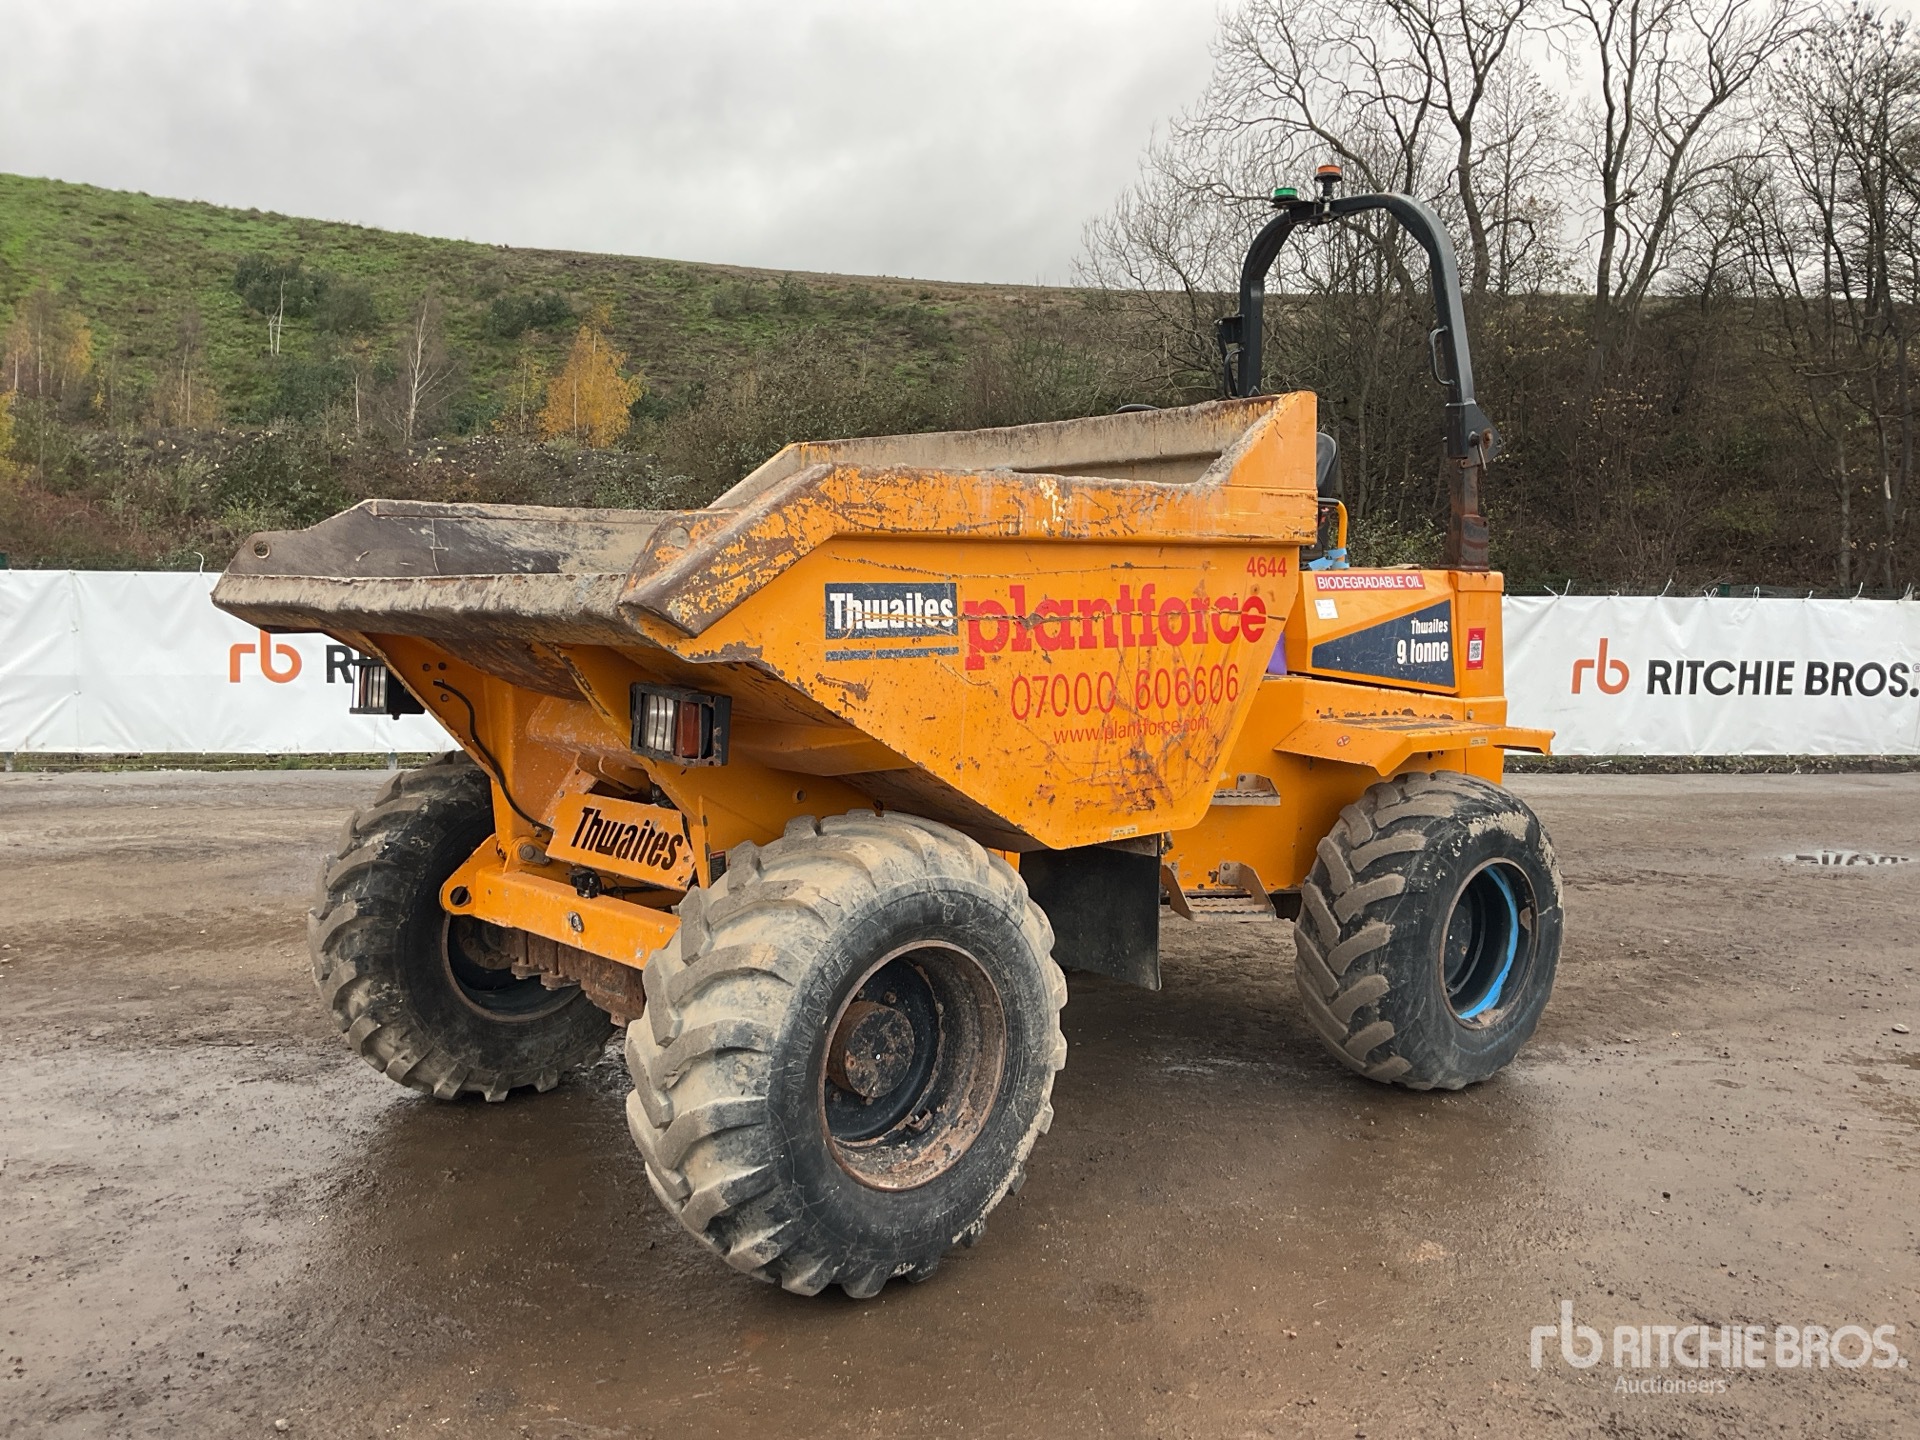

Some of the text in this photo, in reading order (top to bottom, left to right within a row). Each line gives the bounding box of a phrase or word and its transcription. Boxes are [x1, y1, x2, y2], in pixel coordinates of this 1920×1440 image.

[1246, 556, 1287, 578] 4644
[1317, 574, 1423, 590] BIODEGRADABLE OIL
[829, 592, 954, 630] Thwaites
[964, 583, 1267, 671] plantforce
[1411, 618, 1449, 635] Thwaites
[1397, 639, 1449, 664] 9 tonne
[1571, 638, 1630, 695] rb
[1010, 664, 1239, 721] 07000 606606
[1647, 660, 1919, 698] RITCHIE BROS.
[571, 806, 684, 871] Thwaites
